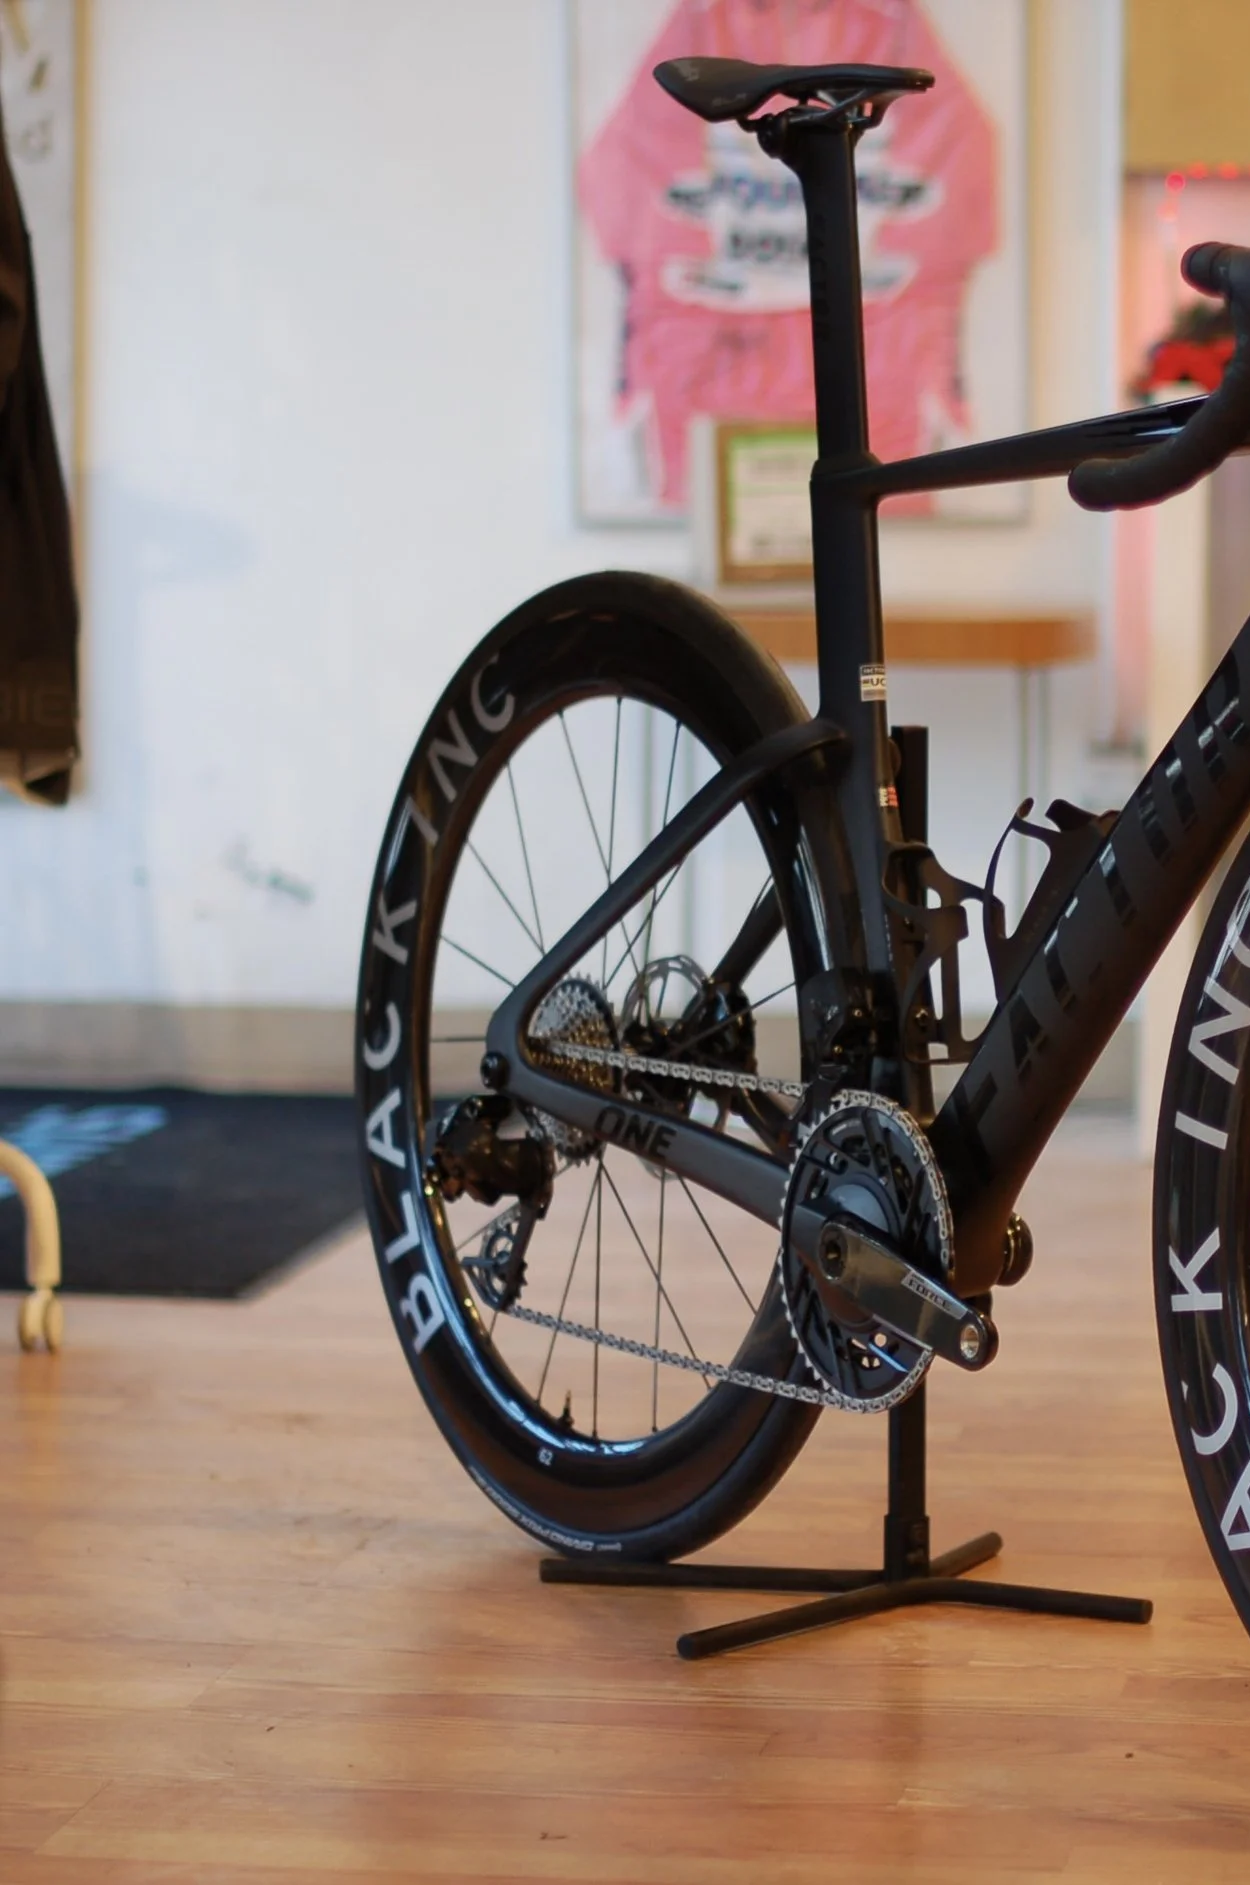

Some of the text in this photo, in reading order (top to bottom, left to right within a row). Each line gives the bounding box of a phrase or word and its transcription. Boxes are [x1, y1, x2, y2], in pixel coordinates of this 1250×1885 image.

[363, 653, 515, 1354] BLACK INC
[594, 1106, 678, 1160] ONE
